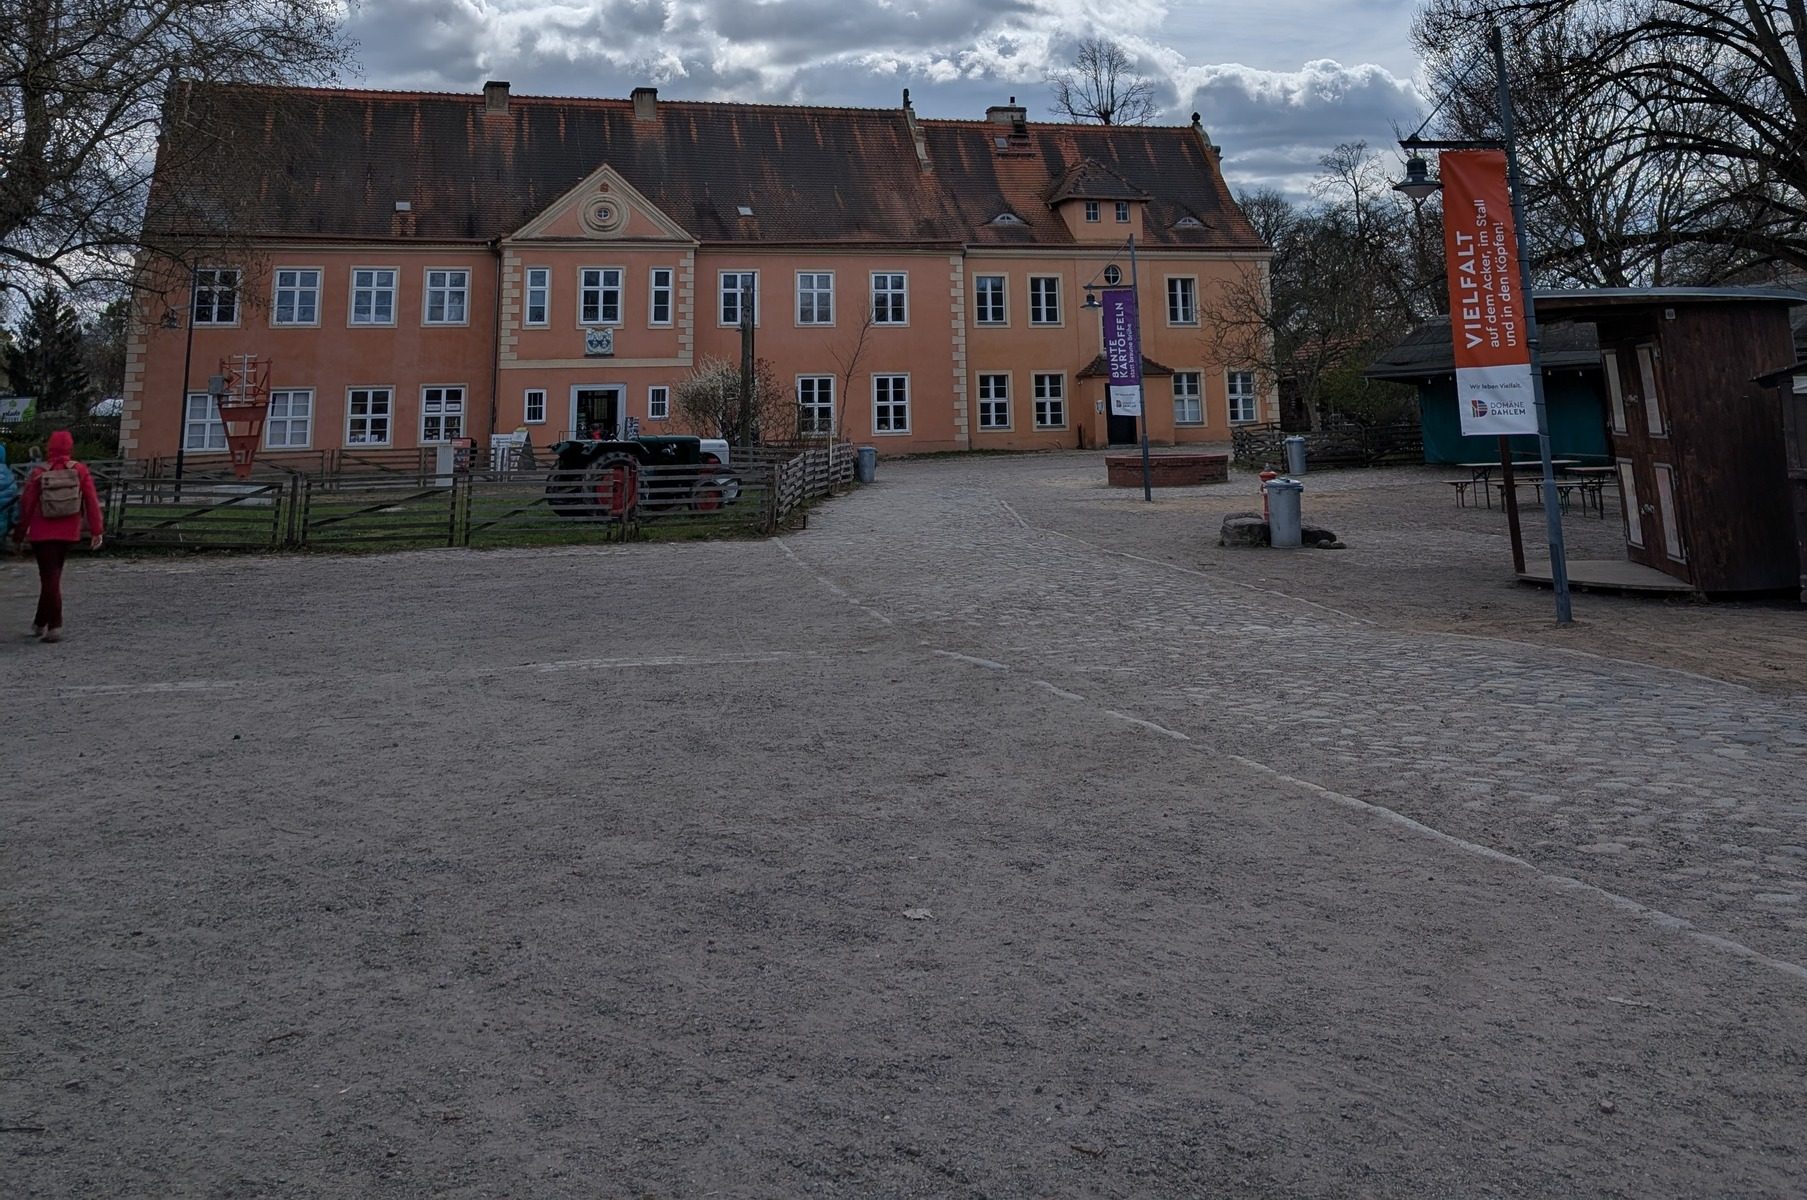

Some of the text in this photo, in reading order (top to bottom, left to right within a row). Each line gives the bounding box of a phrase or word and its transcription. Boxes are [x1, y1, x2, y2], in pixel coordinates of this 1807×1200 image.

[1456, 231, 1483, 349] VIELFALT
[1473, 199, 1500, 348] auf dem Acker, im Stall
[1493, 222, 1516, 347] und in den Köpfen!
[1109, 339, 1119, 378] BUNTE
[1115, 302, 1128, 378] KARTOFFELN
